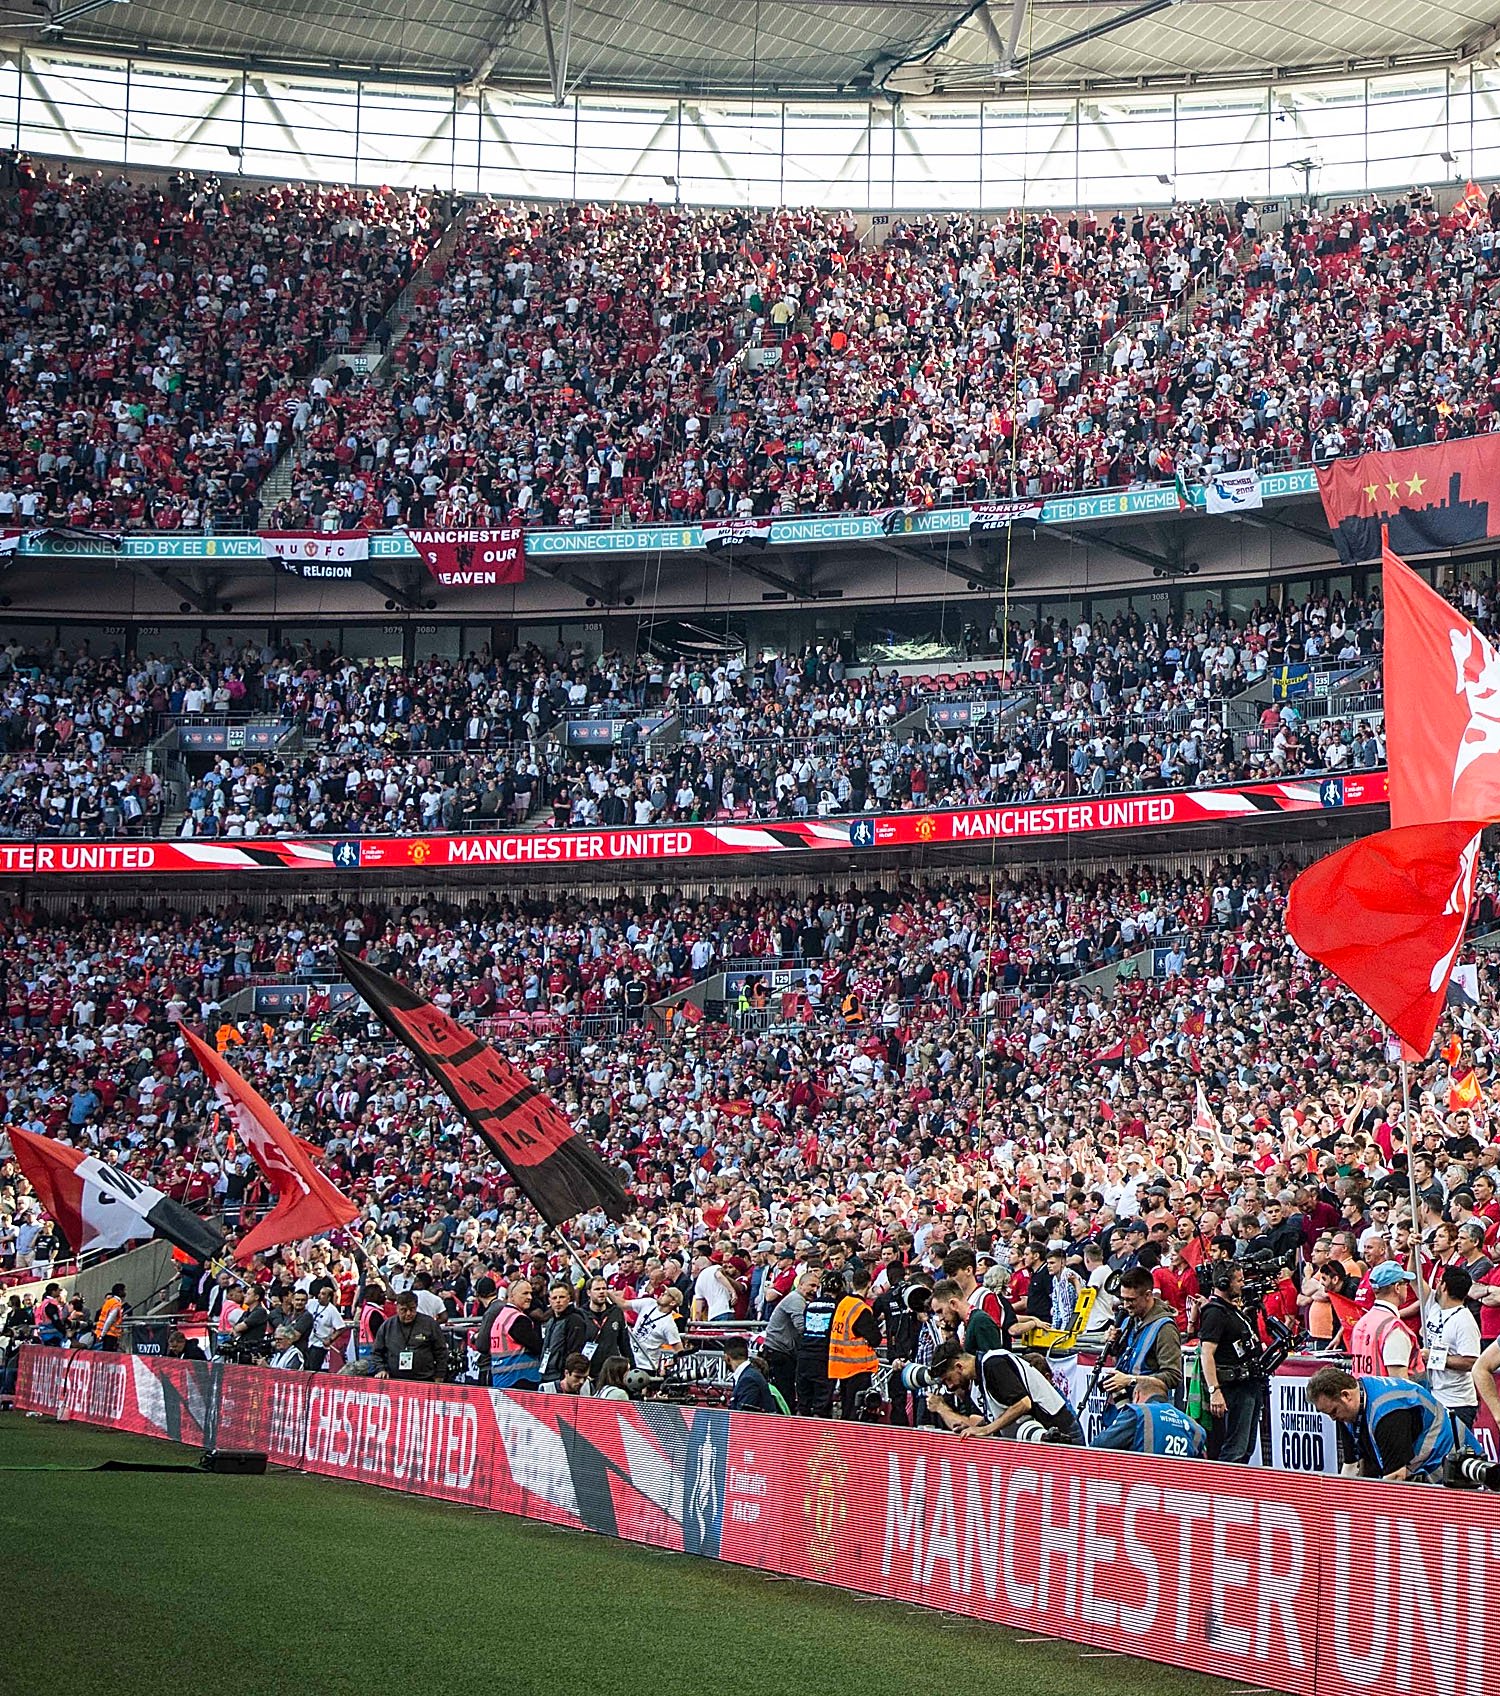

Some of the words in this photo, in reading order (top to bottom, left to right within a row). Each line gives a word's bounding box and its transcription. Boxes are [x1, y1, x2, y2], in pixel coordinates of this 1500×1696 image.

[873, 216, 888, 225] 533
[1290, 476, 1309, 490] BY
[1042, 499, 1078, 519] CTED
[1079, 500, 1097, 514] BY
[1100, 499, 1115, 513] EE
[409, 528, 521, 544] MANCHESTER
[771, 522, 860, 540] CONNECTED
[863, 521, 881, 534] BY
[918, 515, 969, 530] WEMBL
[158, 543, 179, 554] BY
[183, 543, 202, 554] EE
[223, 543, 265, 554] WEM
[543, 534, 635, 550] CONNECTED
[639, 534, 658, 546] BY
[662, 533, 678, 545] EE
[483, 548, 517, 563] OUR
[303, 566, 352, 578] RELIGION
[996, 604, 1015, 613] 302
[1316, 677, 1328, 685] 235
[972, 706, 985, 715] 234
[230, 731, 244, 739] 232
[952, 805, 1092, 837] MANCHESTER
[1099, 798, 1174, 826] UNITED
[448, 836, 604, 862] MANCHESTER
[610, 832, 692, 856] UNITED
[62, 847, 154, 869] UNITED
[776, 974, 788, 984] 129
[30, 1355, 90, 1413] MANCHESTER
[91, 1361, 127, 1420] UNITED
[1280, 1386, 1296, 1411] I'M
[1160, 1415, 1183, 1425] WEMBLEY
[1280, 1412, 1323, 1433] SOMETHING
[269, 1383, 390, 1474] MANCHESTER
[395, 1396, 478, 1489] UNITED
[1165, 1434, 1189, 1457] 262
[1281, 1431, 1325, 1471] GOOD
[882, 1451, 1305, 1672] MANCHESTER
